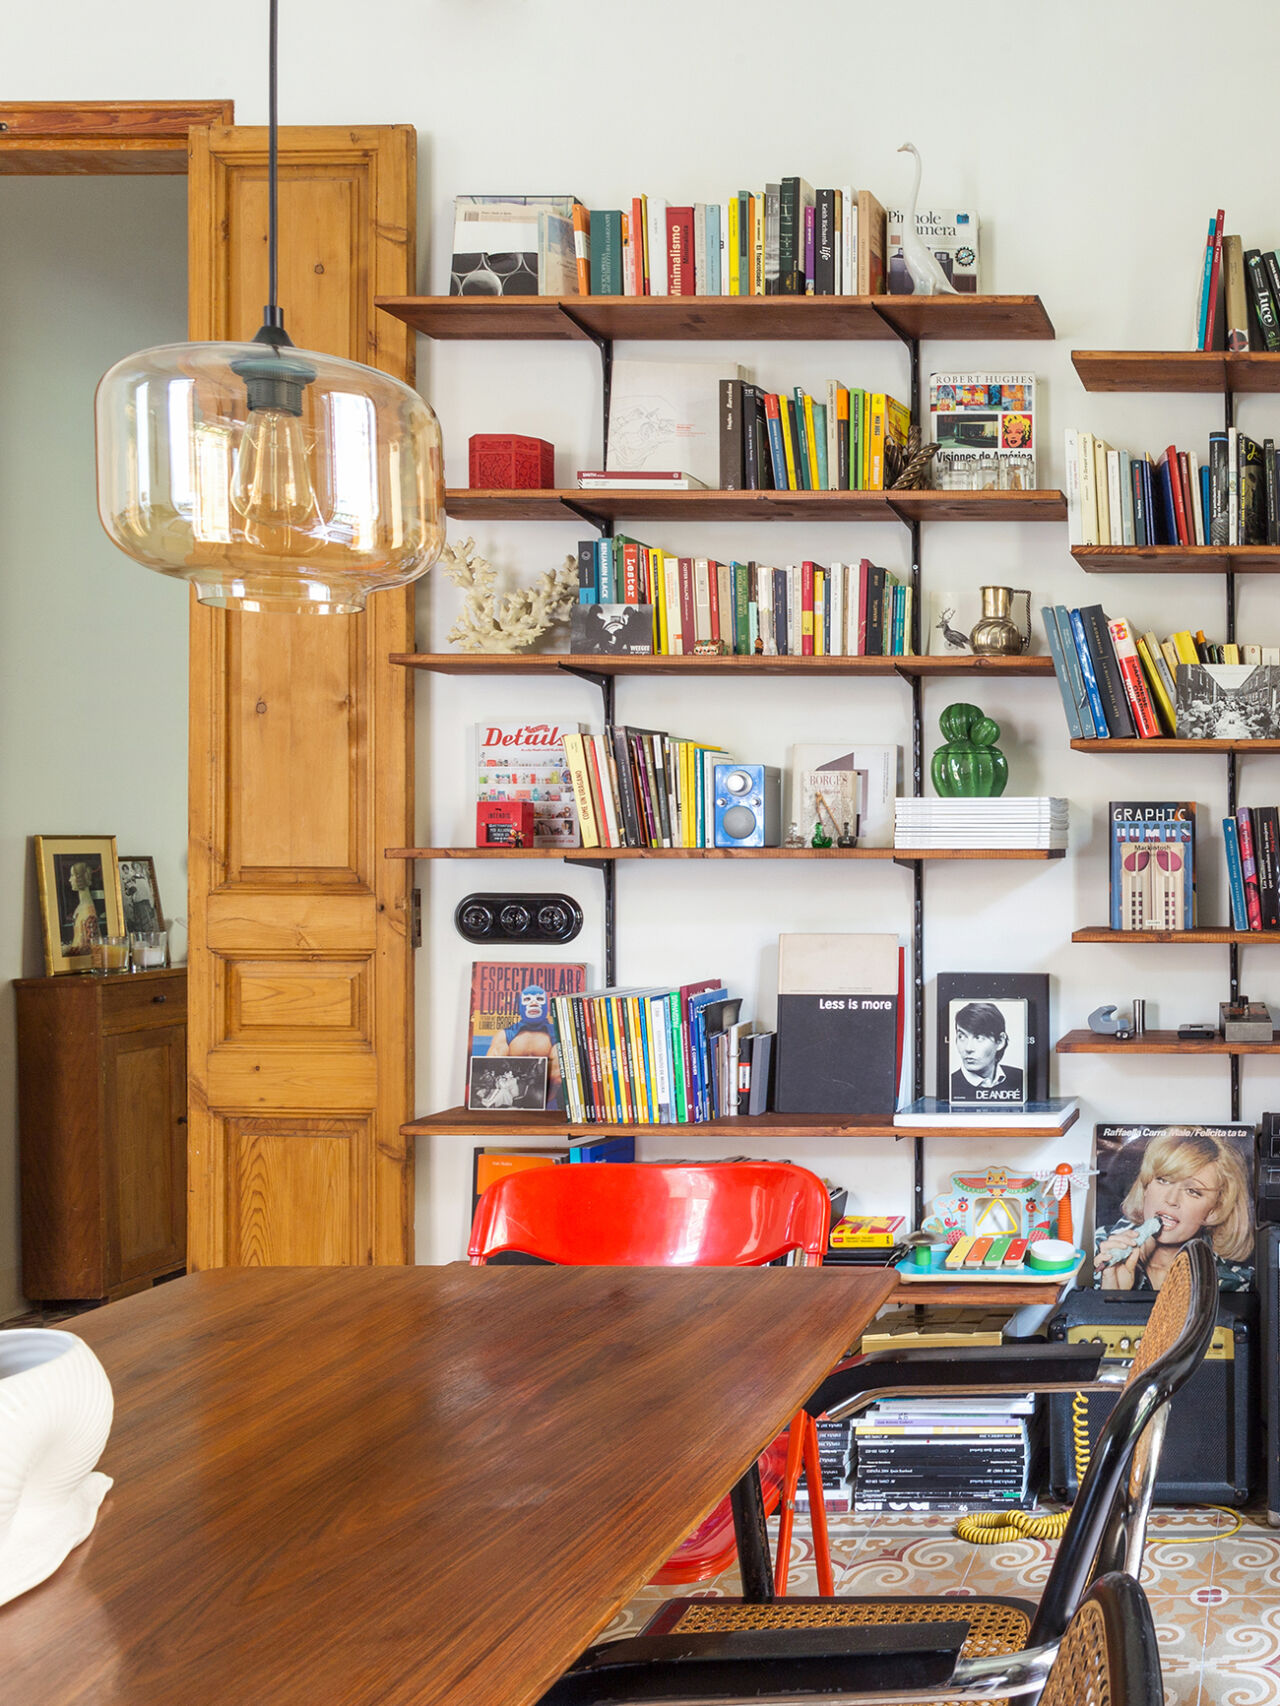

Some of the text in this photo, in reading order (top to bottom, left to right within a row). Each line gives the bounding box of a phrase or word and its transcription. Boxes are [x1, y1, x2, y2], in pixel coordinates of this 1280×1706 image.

[669, 225, 682, 296] Minimalismo
[819, 246, 831, 261] life
[936, 376, 1033, 384] ROBERT HUGHES
[936, 451, 976, 463] Visiones
[626, 558, 636, 598] Lester
[1132, 664, 1148, 708] JAPANESE
[1133, 685, 1150, 730] GRAPHICS
[481, 726, 564, 746] Details
[809, 775, 848, 785] BORGES
[581, 806, 590, 820] COME
[1113, 808, 1186, 821] GRAPHIC
[480, 966, 574, 993] ESPECTACULAR
[480, 991, 520, 1016] LUCHA
[820, 998, 892, 1010] Less is more
[976, 1088, 1020, 1100] DE ANDRÉ
[1103, 1128, 1141, 1137] Raffaella
